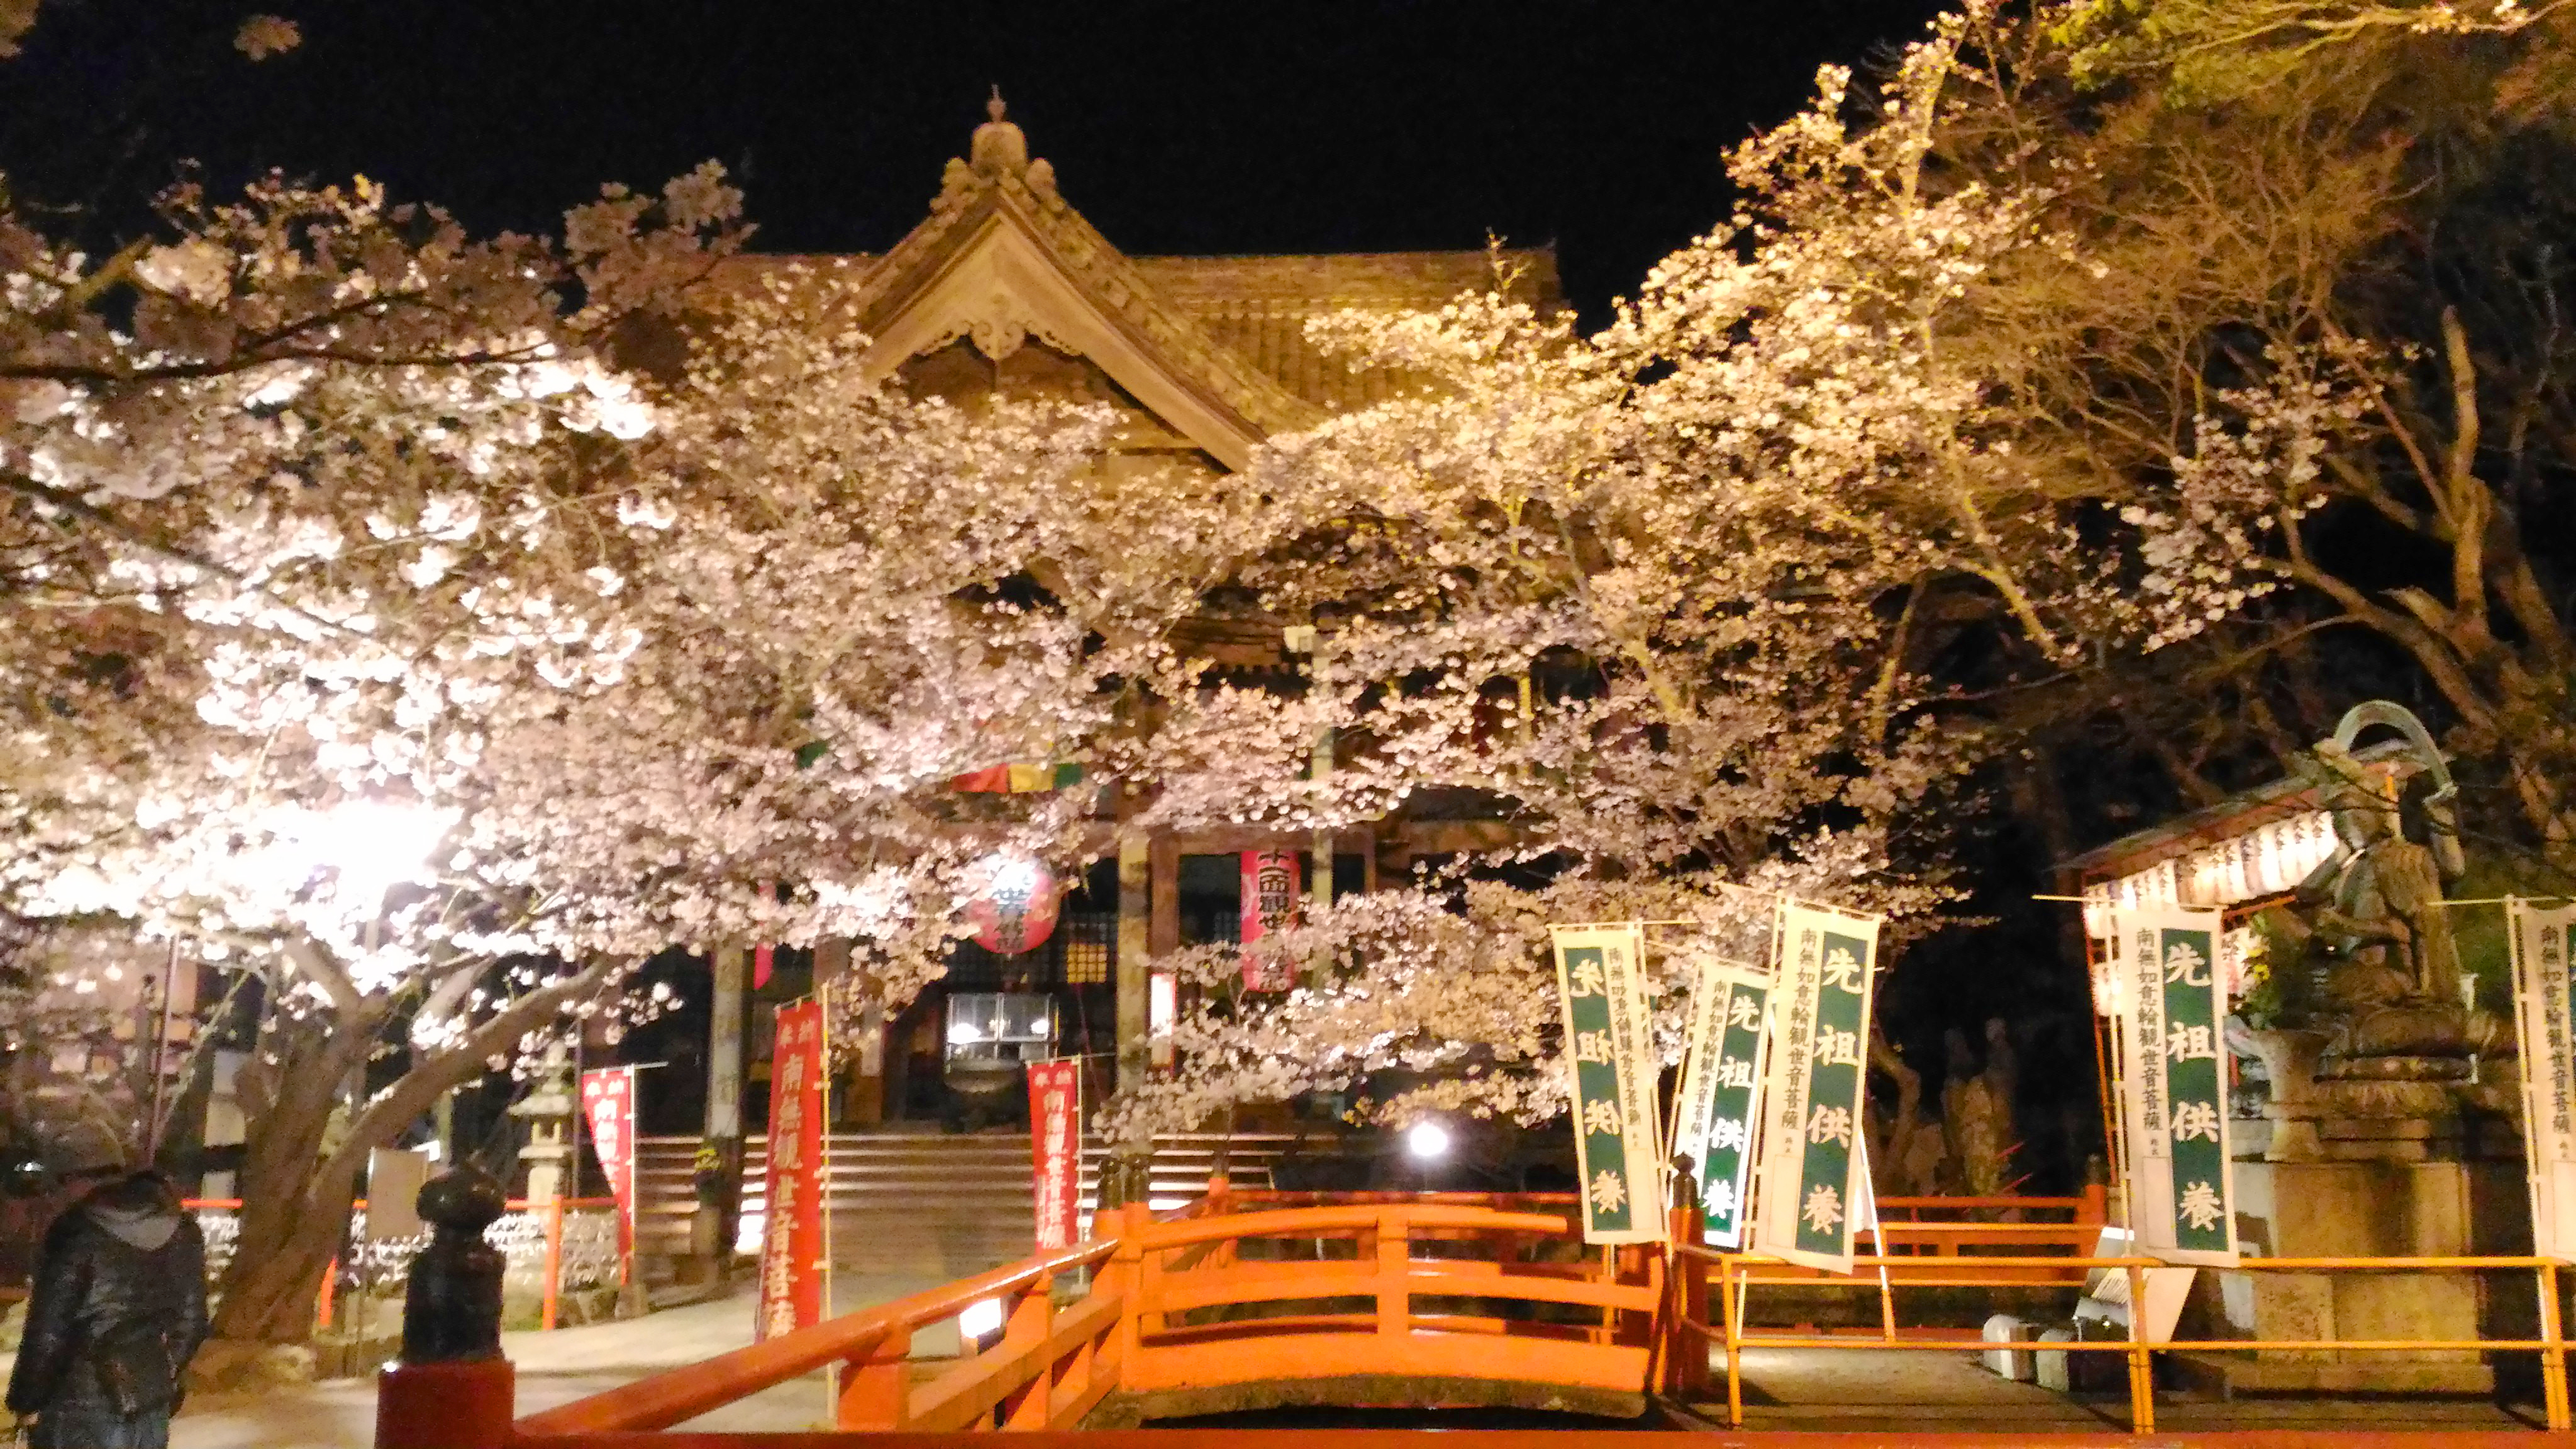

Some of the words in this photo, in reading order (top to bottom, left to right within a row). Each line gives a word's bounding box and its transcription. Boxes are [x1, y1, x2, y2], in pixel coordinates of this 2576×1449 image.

[1702, 994, 1761, 1220] 先祖供養
[1802, 947, 1864, 1236] 先祖供養
[2135, 926, 2163, 1132] 南無如意輪観世音菩薩
[2163, 941, 2224, 1233] 先祖供養
